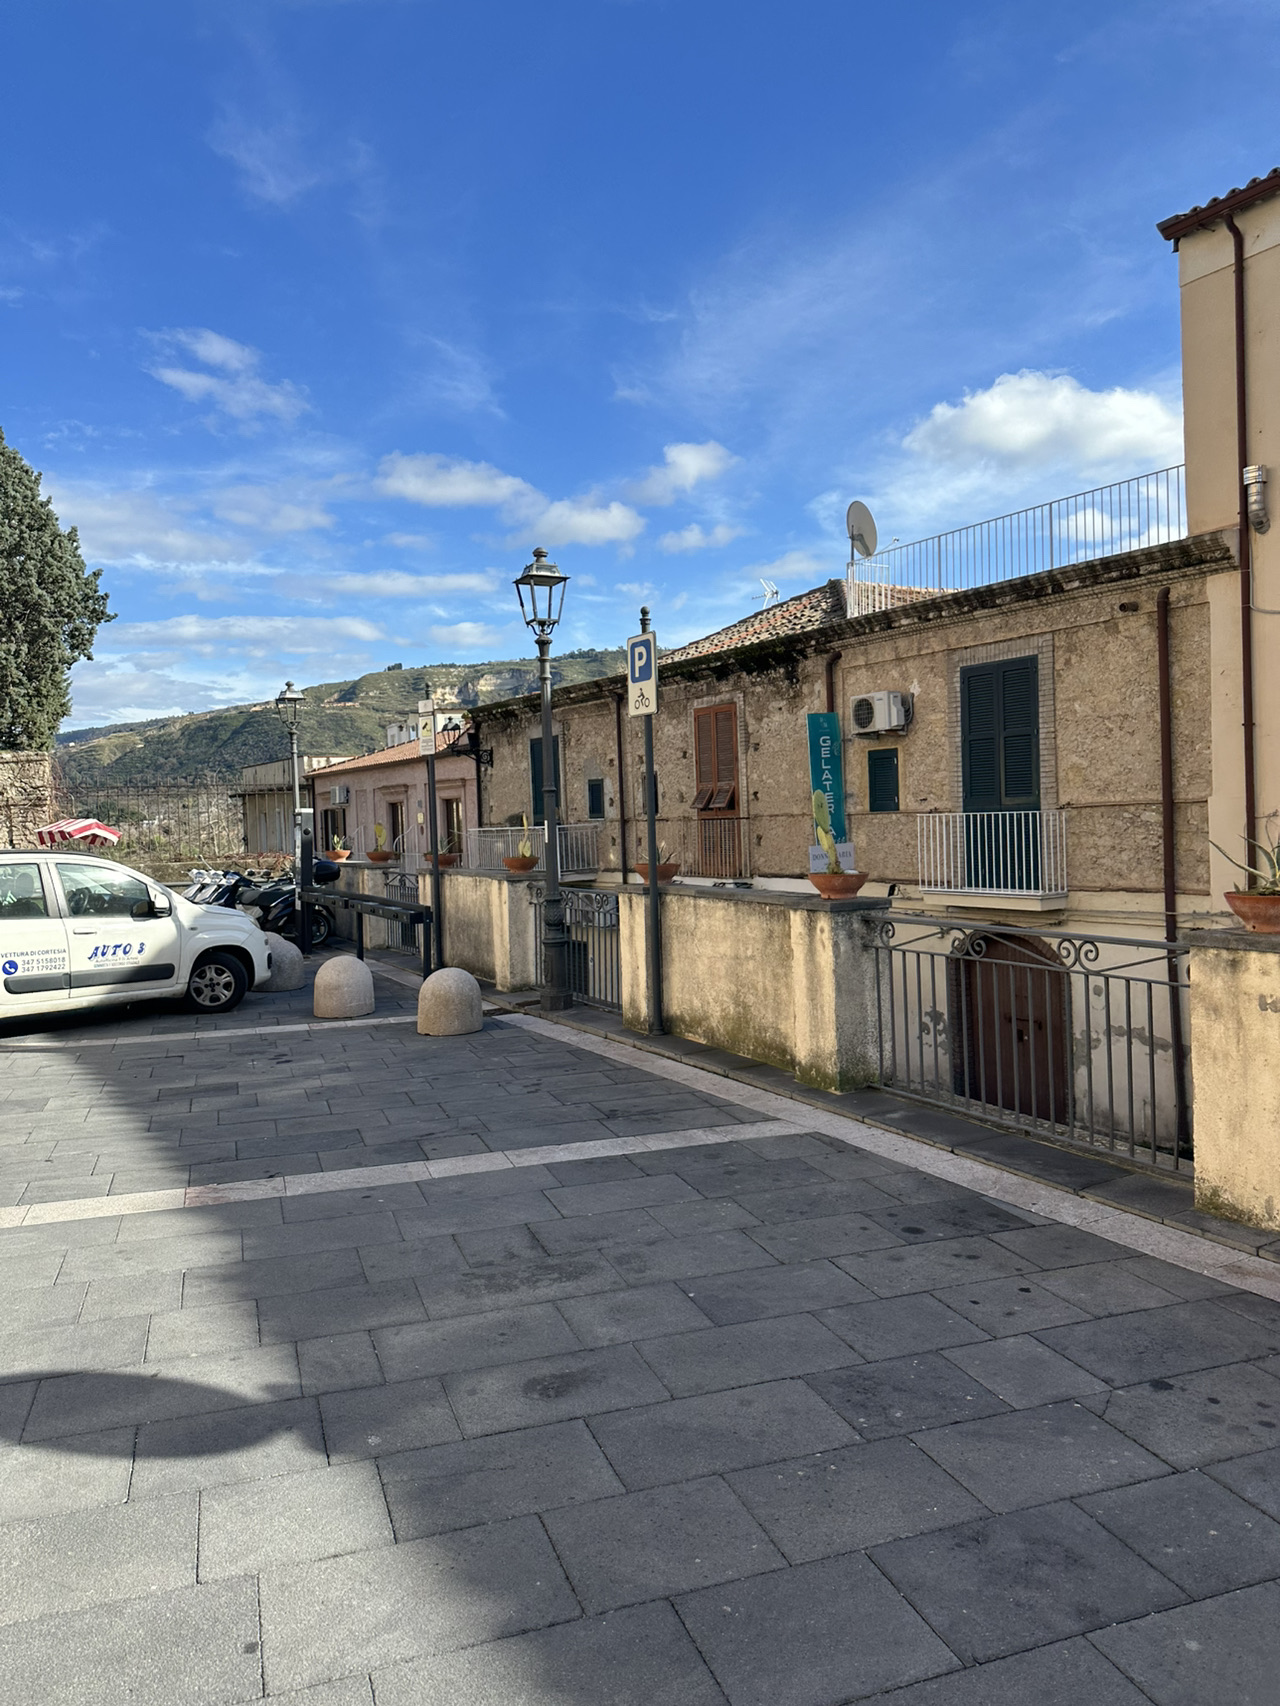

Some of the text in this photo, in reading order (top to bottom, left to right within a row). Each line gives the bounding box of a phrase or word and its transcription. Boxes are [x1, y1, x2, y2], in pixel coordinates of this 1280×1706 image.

[634, 646, 647, 678] P
[87, 942, 146, 960] AUTO 3
[36, 963, 66, 972] 1792422
